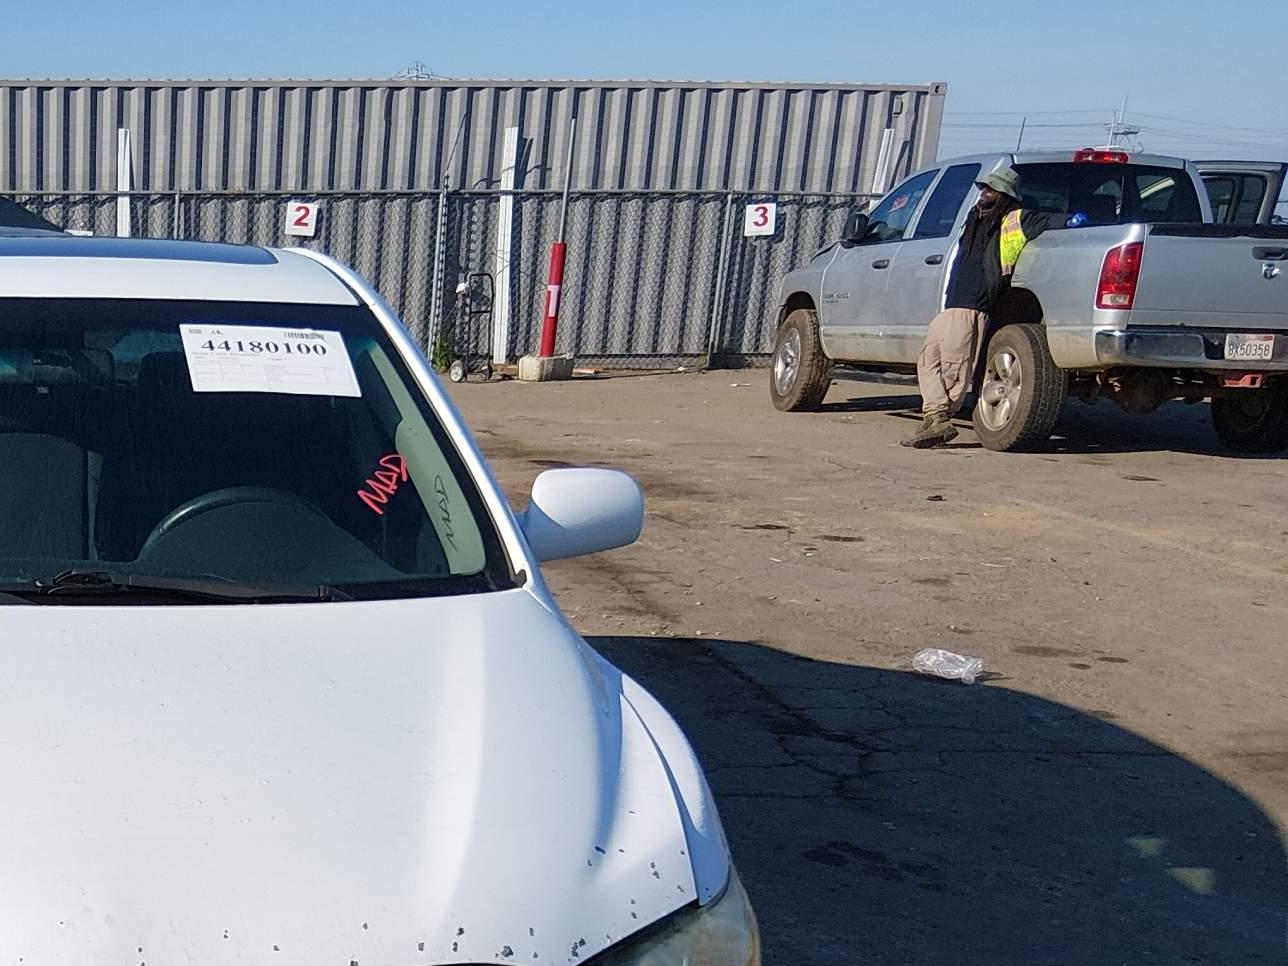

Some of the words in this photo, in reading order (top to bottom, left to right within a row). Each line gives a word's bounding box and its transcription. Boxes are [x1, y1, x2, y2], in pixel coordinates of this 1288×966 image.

[293, 205, 310, 227] 2
[753, 205, 768, 227] 3
[201, 339, 327, 356] 44180100
[357, 454, 408, 515] MAD
